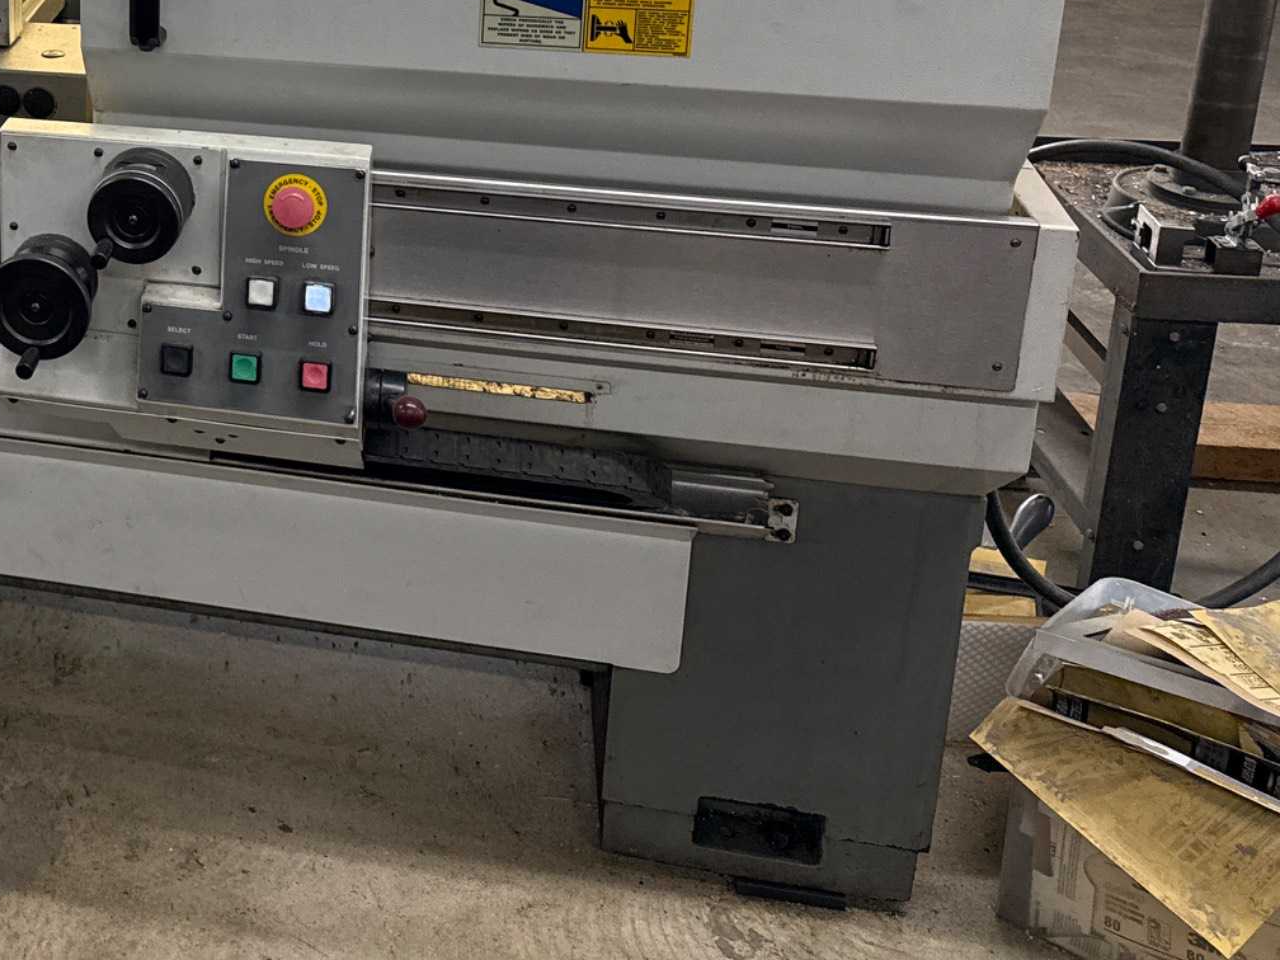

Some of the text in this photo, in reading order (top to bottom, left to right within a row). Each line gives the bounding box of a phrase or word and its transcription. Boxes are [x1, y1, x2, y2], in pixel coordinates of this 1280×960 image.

[312, 187, 324, 206] STOP
[168, 326, 192, 334] SELECT
[1104, 916, 1121, 932] 80
